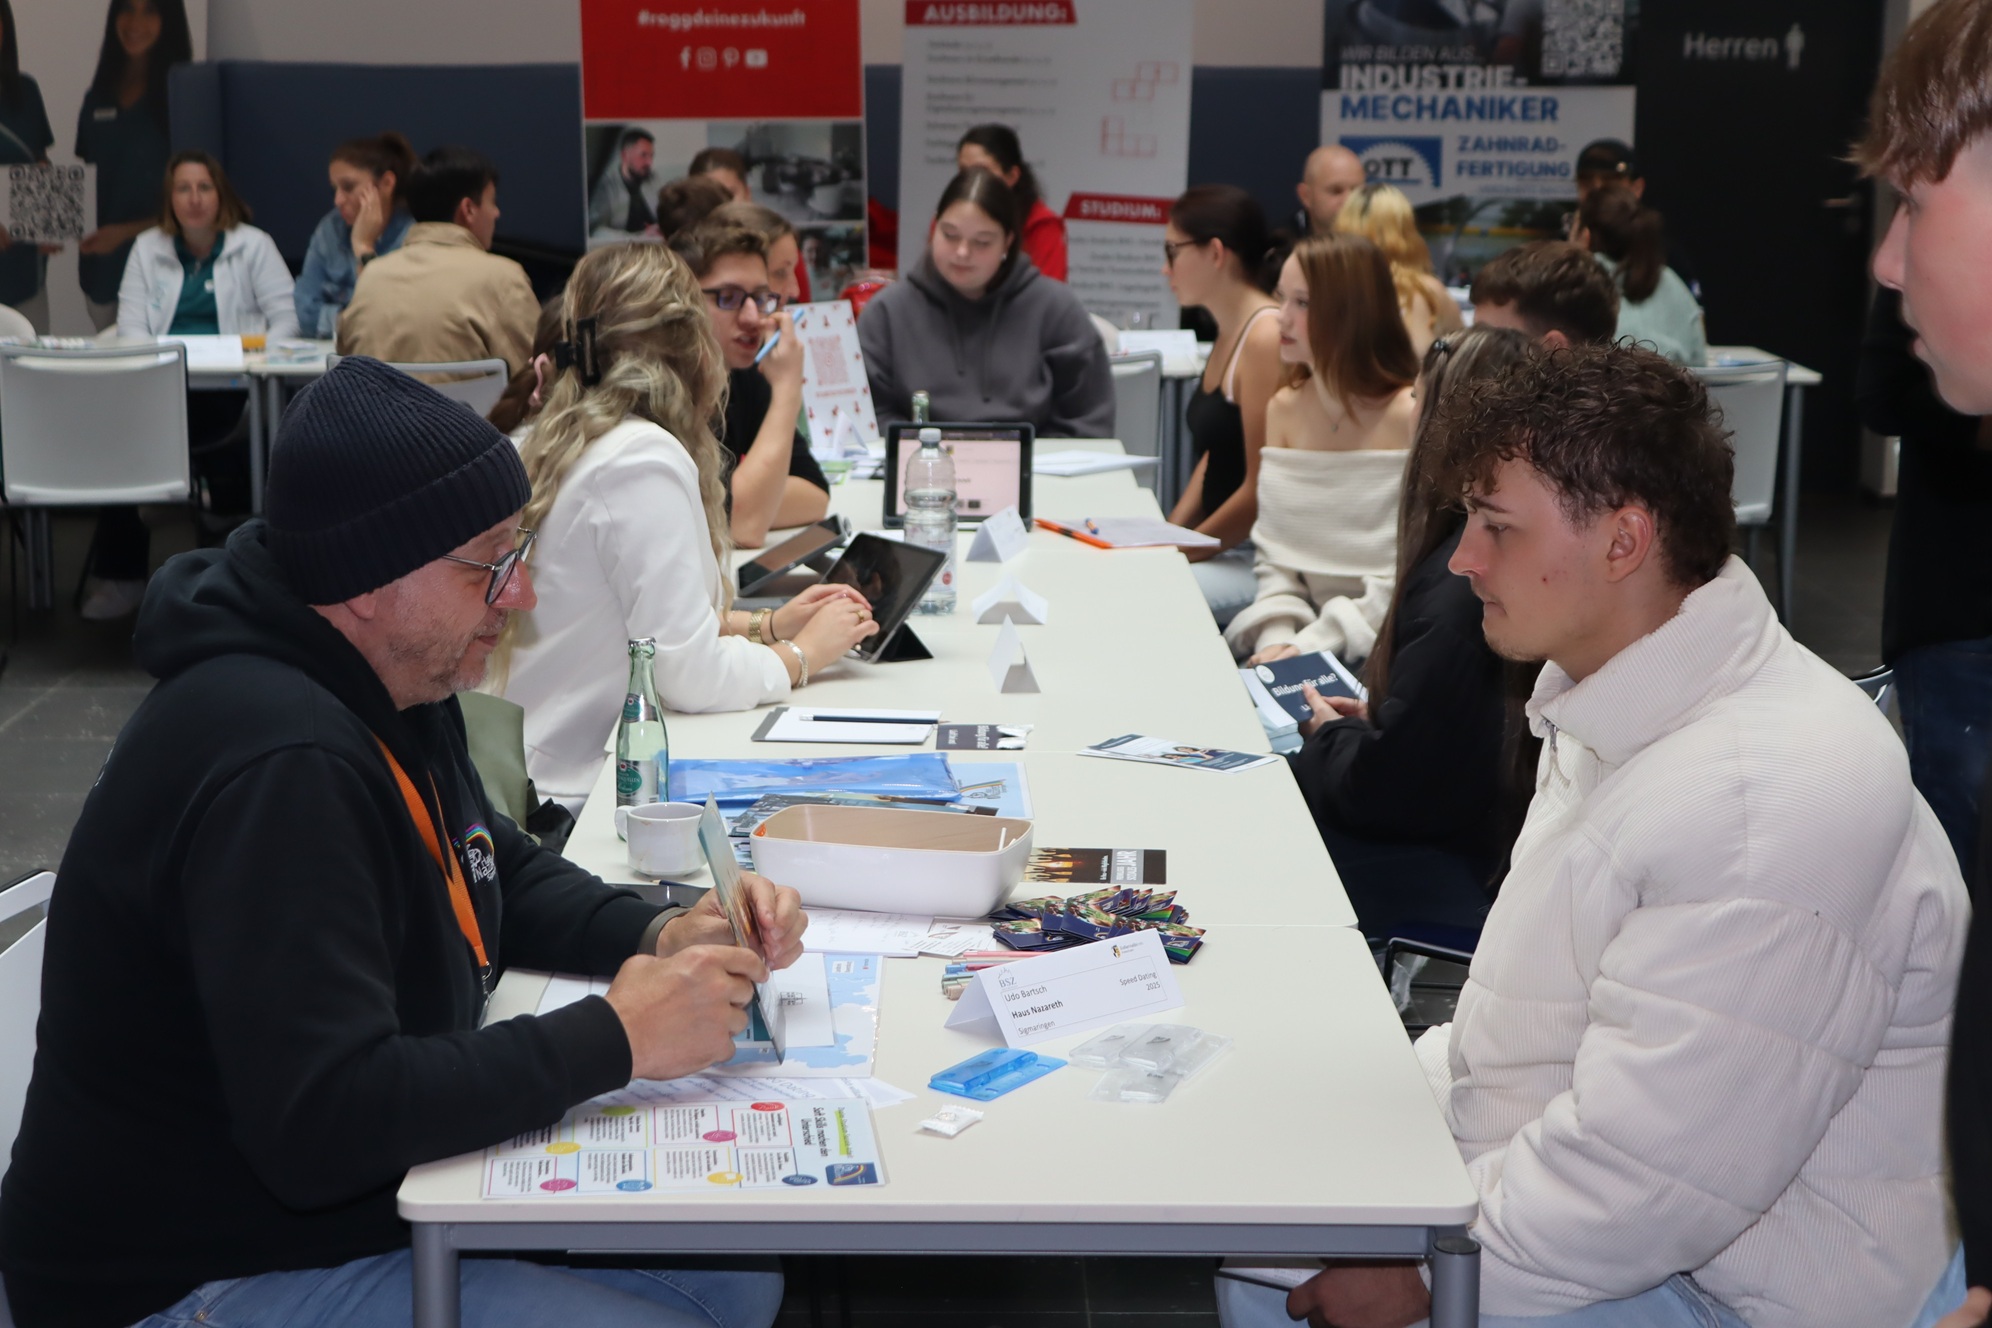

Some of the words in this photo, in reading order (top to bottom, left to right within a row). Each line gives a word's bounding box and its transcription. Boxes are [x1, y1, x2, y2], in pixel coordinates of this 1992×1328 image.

[923, 2, 1067, 22] AUSBILDUNG:
[1340, 45, 1371, 61] WIR
[1374, 45, 1433, 61] BILDEN
[1684, 31, 1779, 60] Herren
[1340, 64, 1528, 89] INDUSTRIE-
[1340, 95, 1559, 121] MECHANIKER
[1457, 135, 1566, 153] ZAHNRAD-
[1457, 160, 1570, 177] FERTIGUNG
[1080, 200, 1161, 218] STUDIUM:
[1318, 672, 1338, 686] alle?
[1116, 850, 1137, 866] JAHR
[998, 976, 1017, 988] BSZ
[1119, 976, 1137, 987] Speed
[1137, 971, 1157, 983] Dating
[1146, 982, 1161, 992] 2025
[1004, 990, 1020, 1002] Udo
[1020, 984, 1048, 999] Bartsch
[1011, 1007, 1030, 1020] Haus
[1030, 999, 1064, 1016] Nazareth
[1018, 1020, 1056, 1035] Sigmaringen
